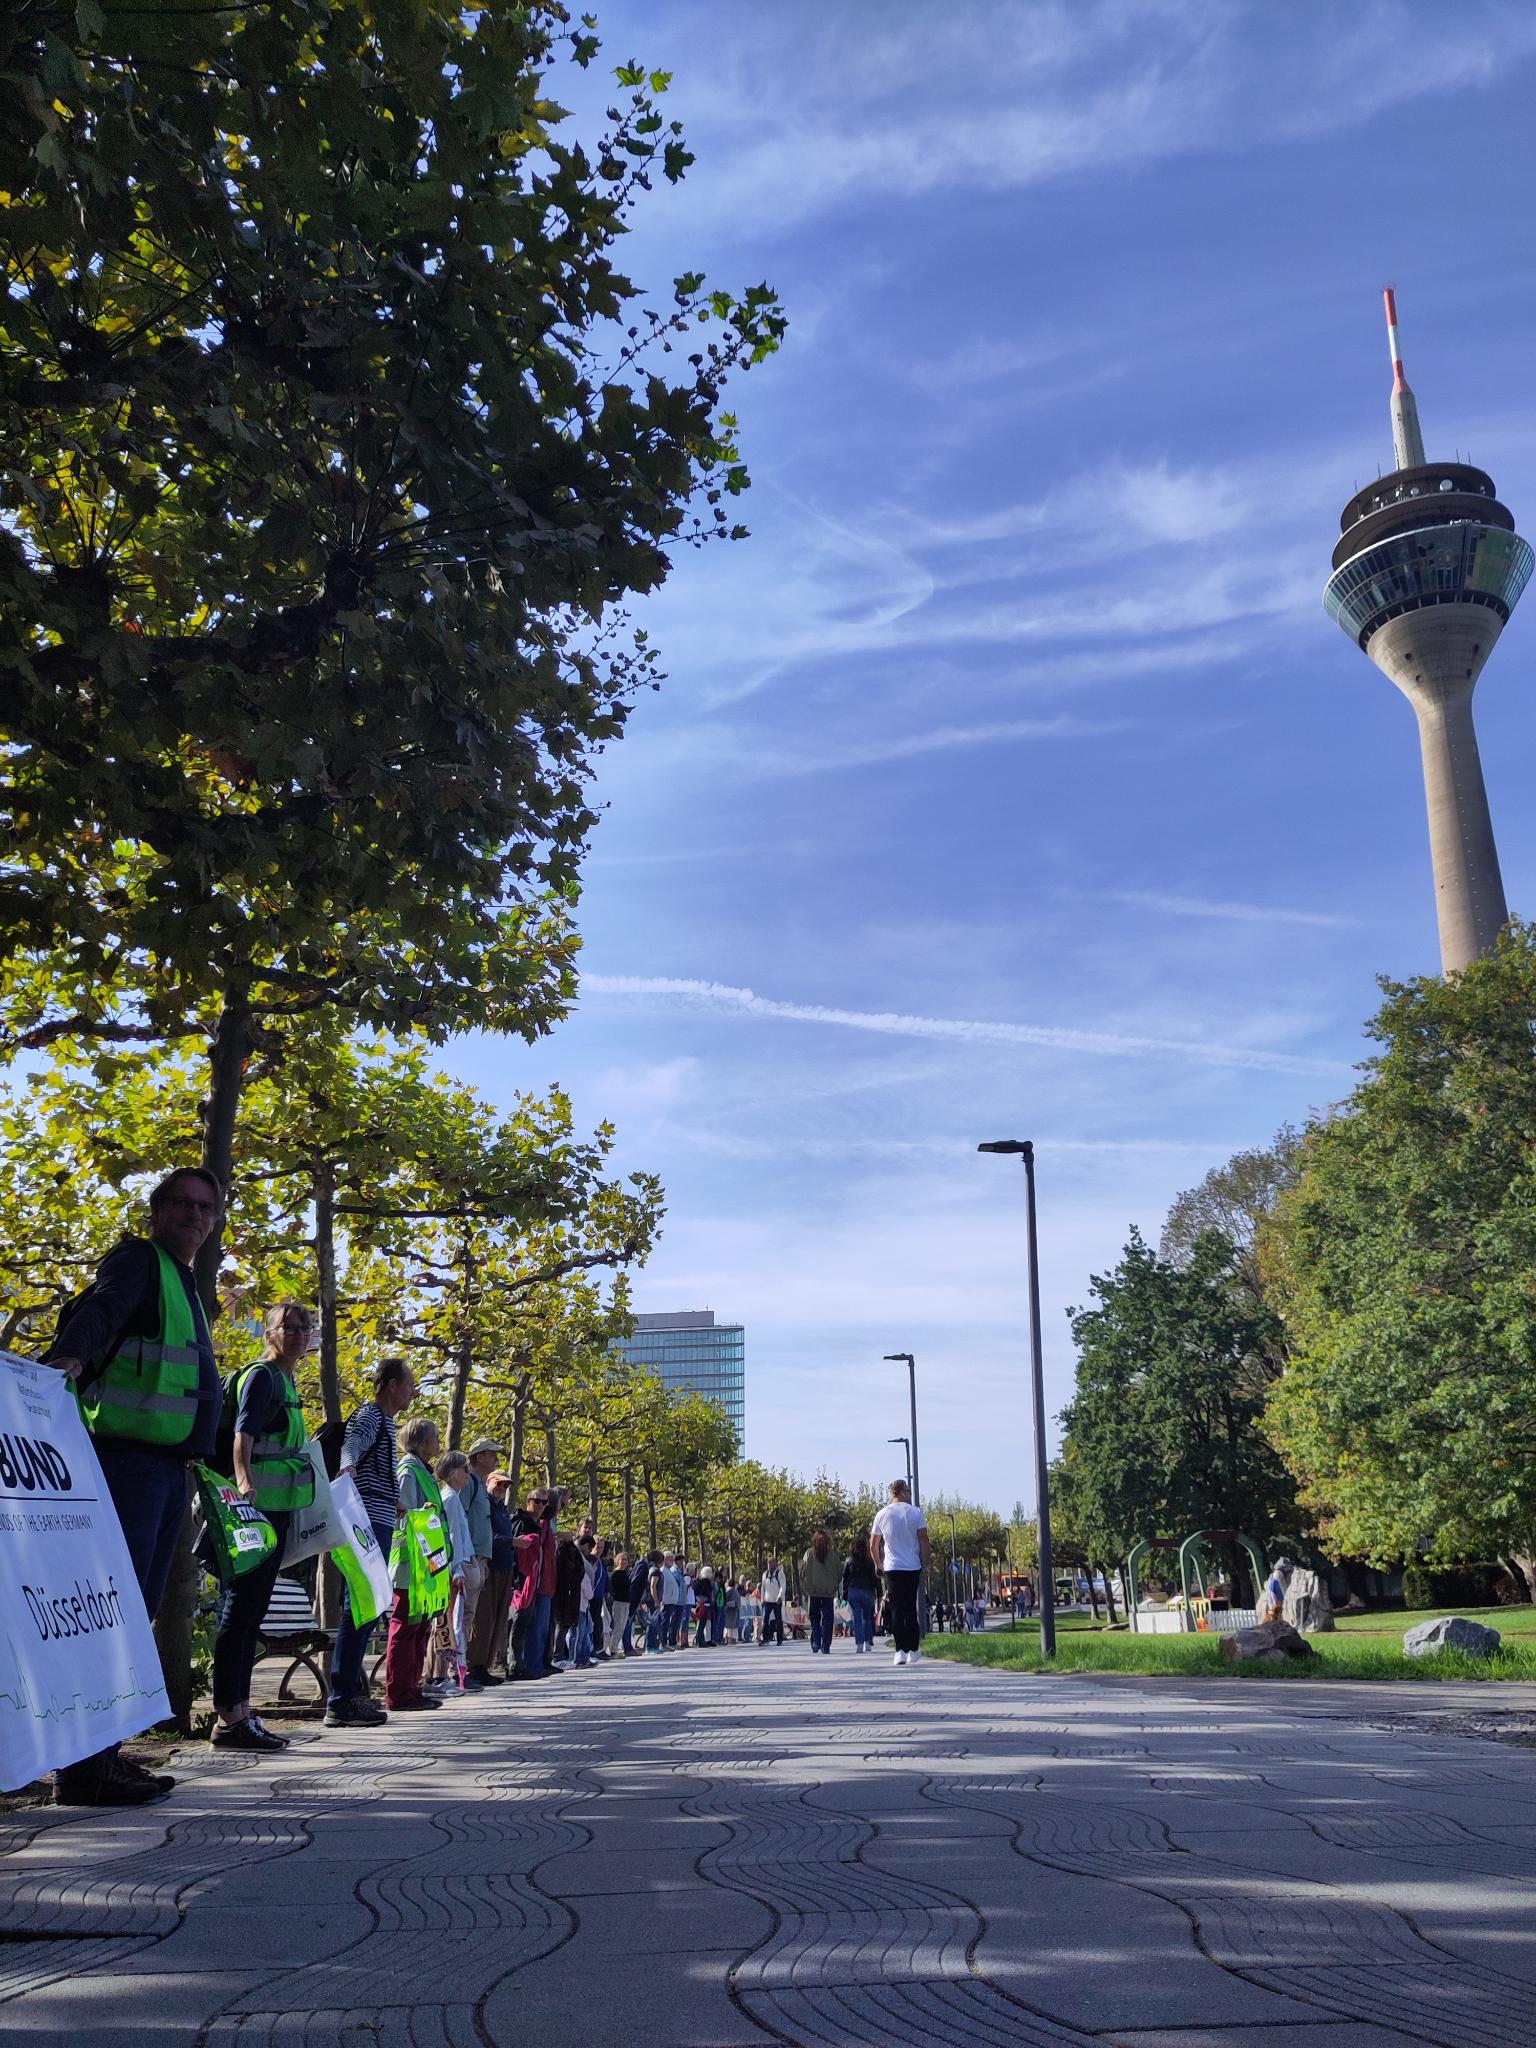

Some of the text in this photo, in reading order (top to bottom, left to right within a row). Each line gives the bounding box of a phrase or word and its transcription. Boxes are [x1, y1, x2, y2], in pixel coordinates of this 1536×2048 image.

[0, 1433, 73, 1491] BUND
[12, 1514, 25, 1532] OF
[22, 1514, 40, 1532] THE
[37, 1514, 62, 1532] EARTH
[60, 1514, 94, 1531] GERMANY
[308, 1521, 327, 1536] BUND
[21, 1576, 126, 1641] Düsseldorf
